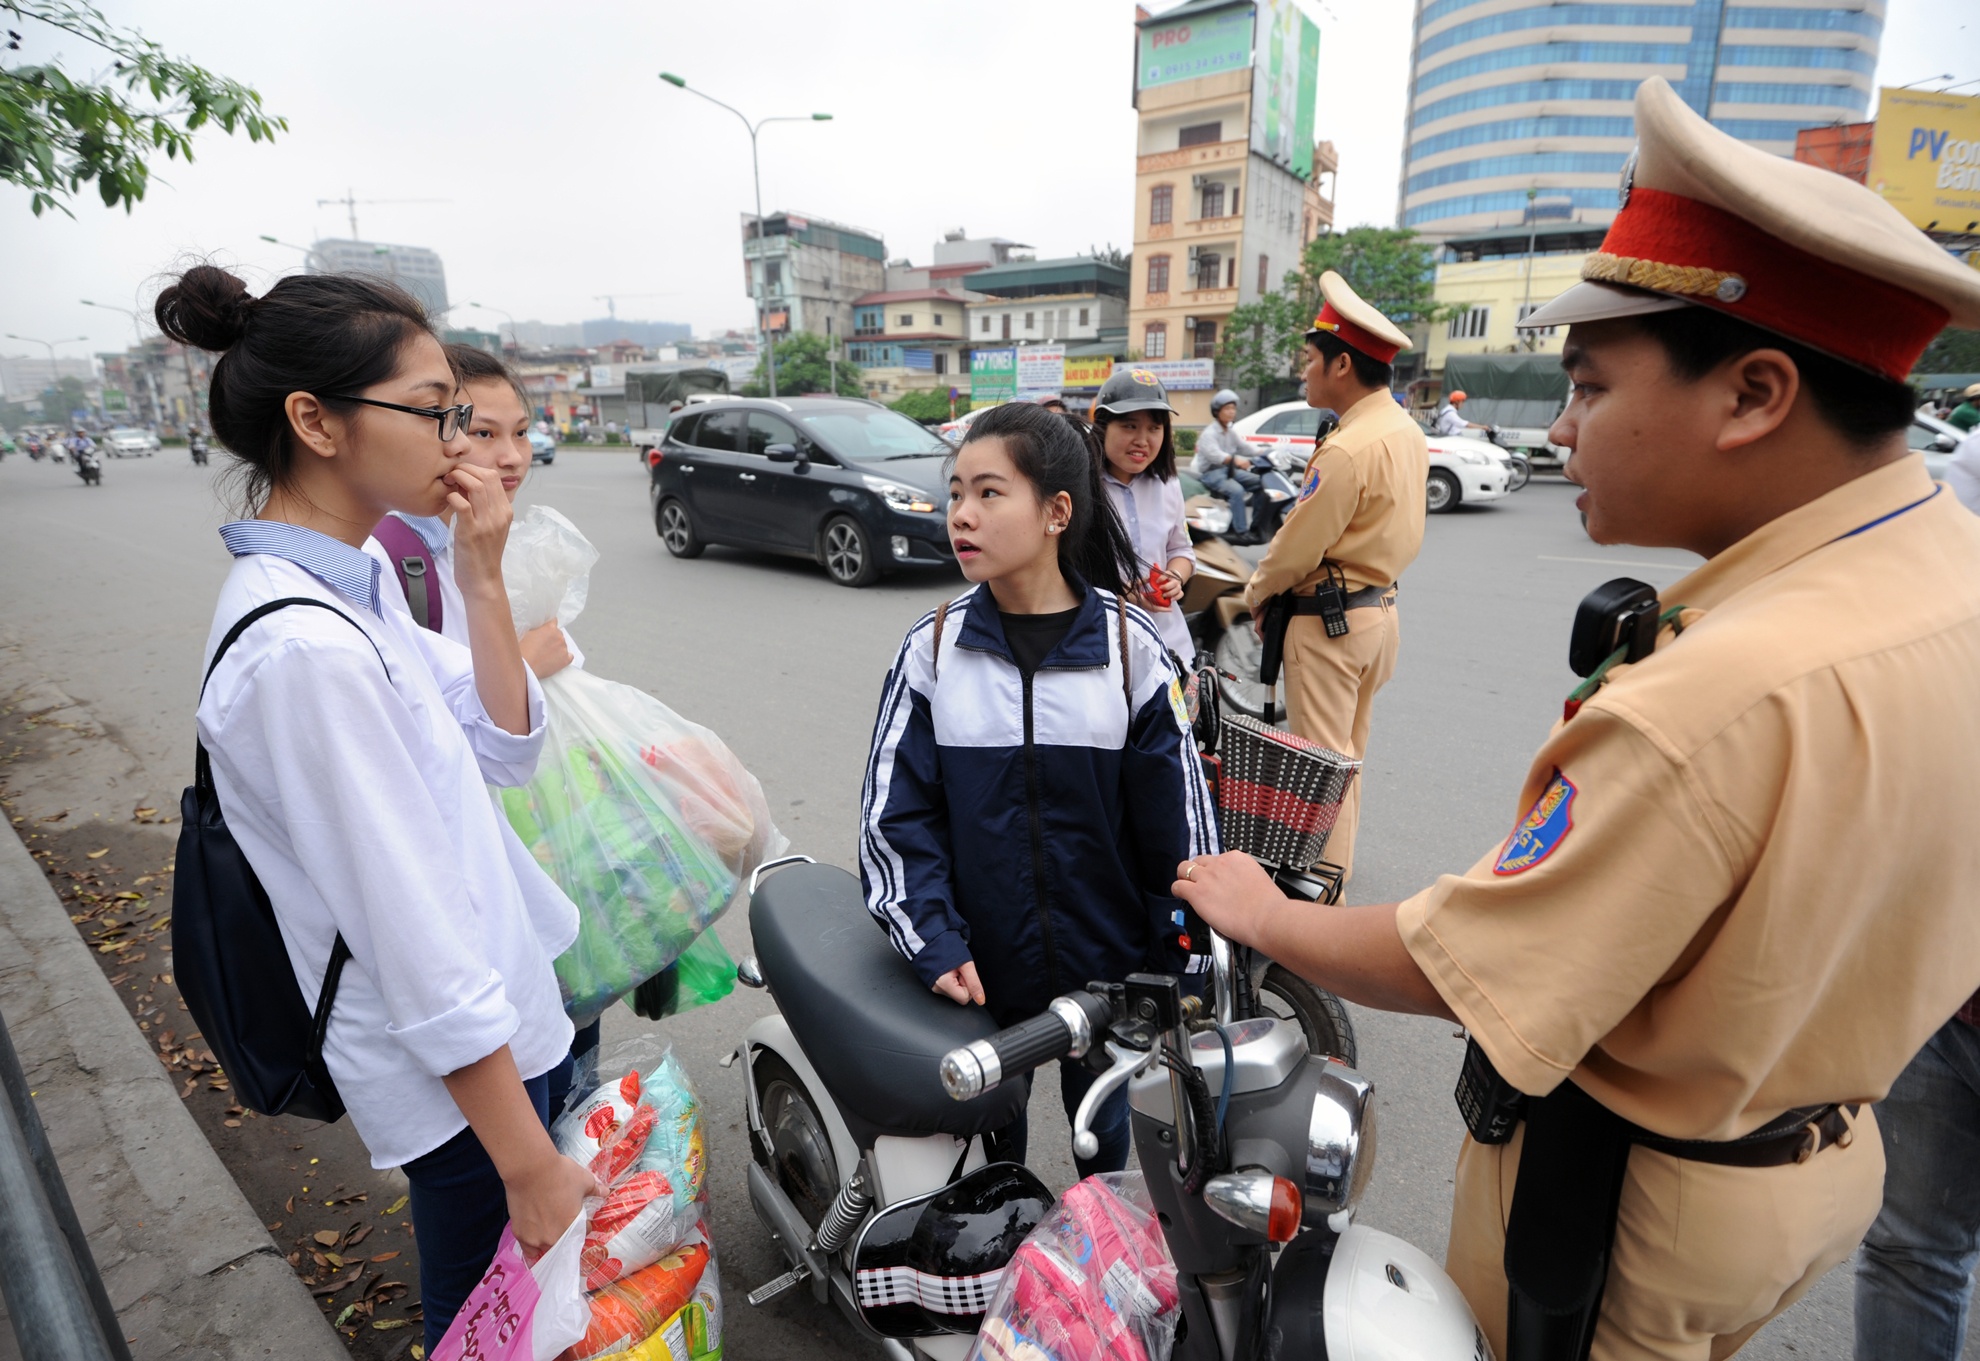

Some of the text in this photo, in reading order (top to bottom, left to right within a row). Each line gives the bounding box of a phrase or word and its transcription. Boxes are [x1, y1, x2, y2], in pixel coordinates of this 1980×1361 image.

[1152, 25, 1191, 50] PRO
[989, 351, 1014, 370] YONEX
[691, 1154, 699, 1185] Oishi
